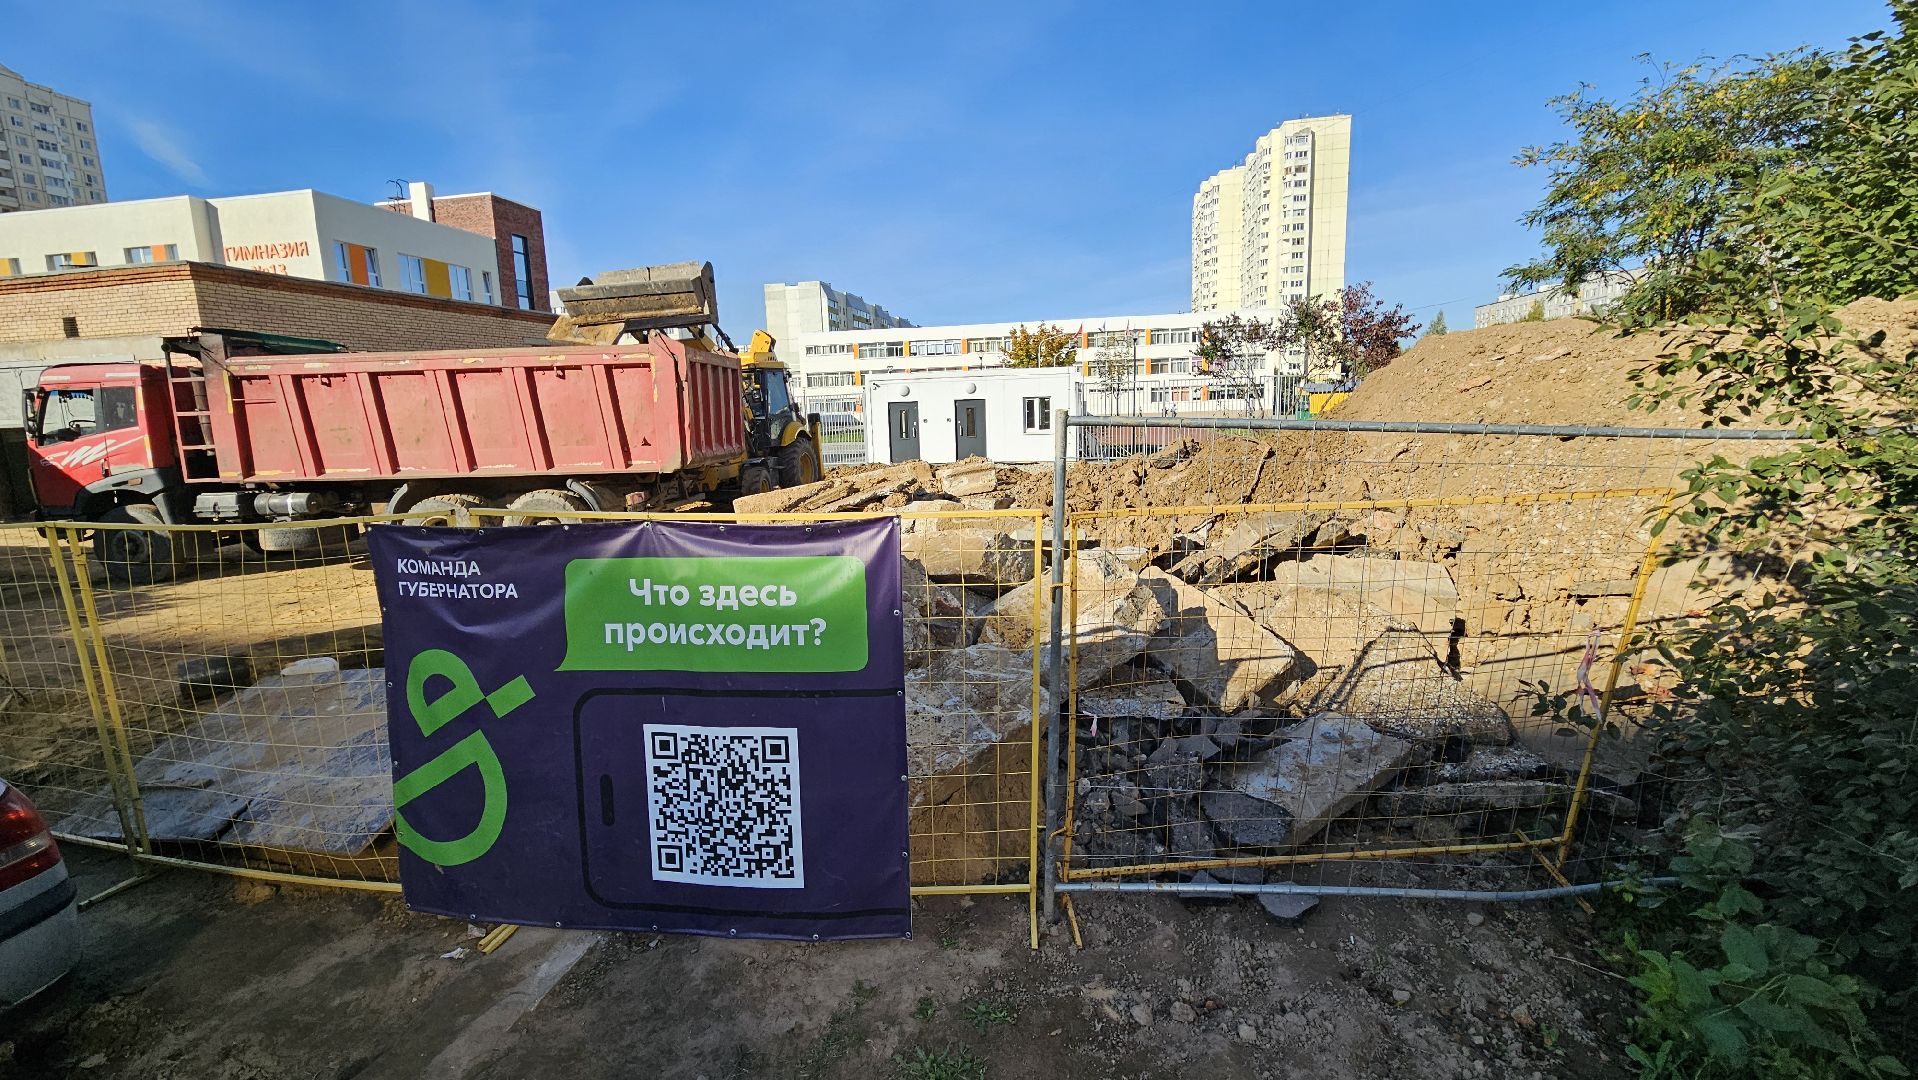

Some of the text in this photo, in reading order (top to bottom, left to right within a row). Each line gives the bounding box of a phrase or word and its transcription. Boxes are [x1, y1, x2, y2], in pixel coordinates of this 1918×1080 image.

[224, 240, 310, 262] ГИМНАЗИЯ
[397, 558, 481, 578] КОМАНДА
[398, 581, 519, 599] ГУБЕРНАТОРА
[629, 578, 798, 611] Что здесь
[604, 617, 827, 652] происходит?
